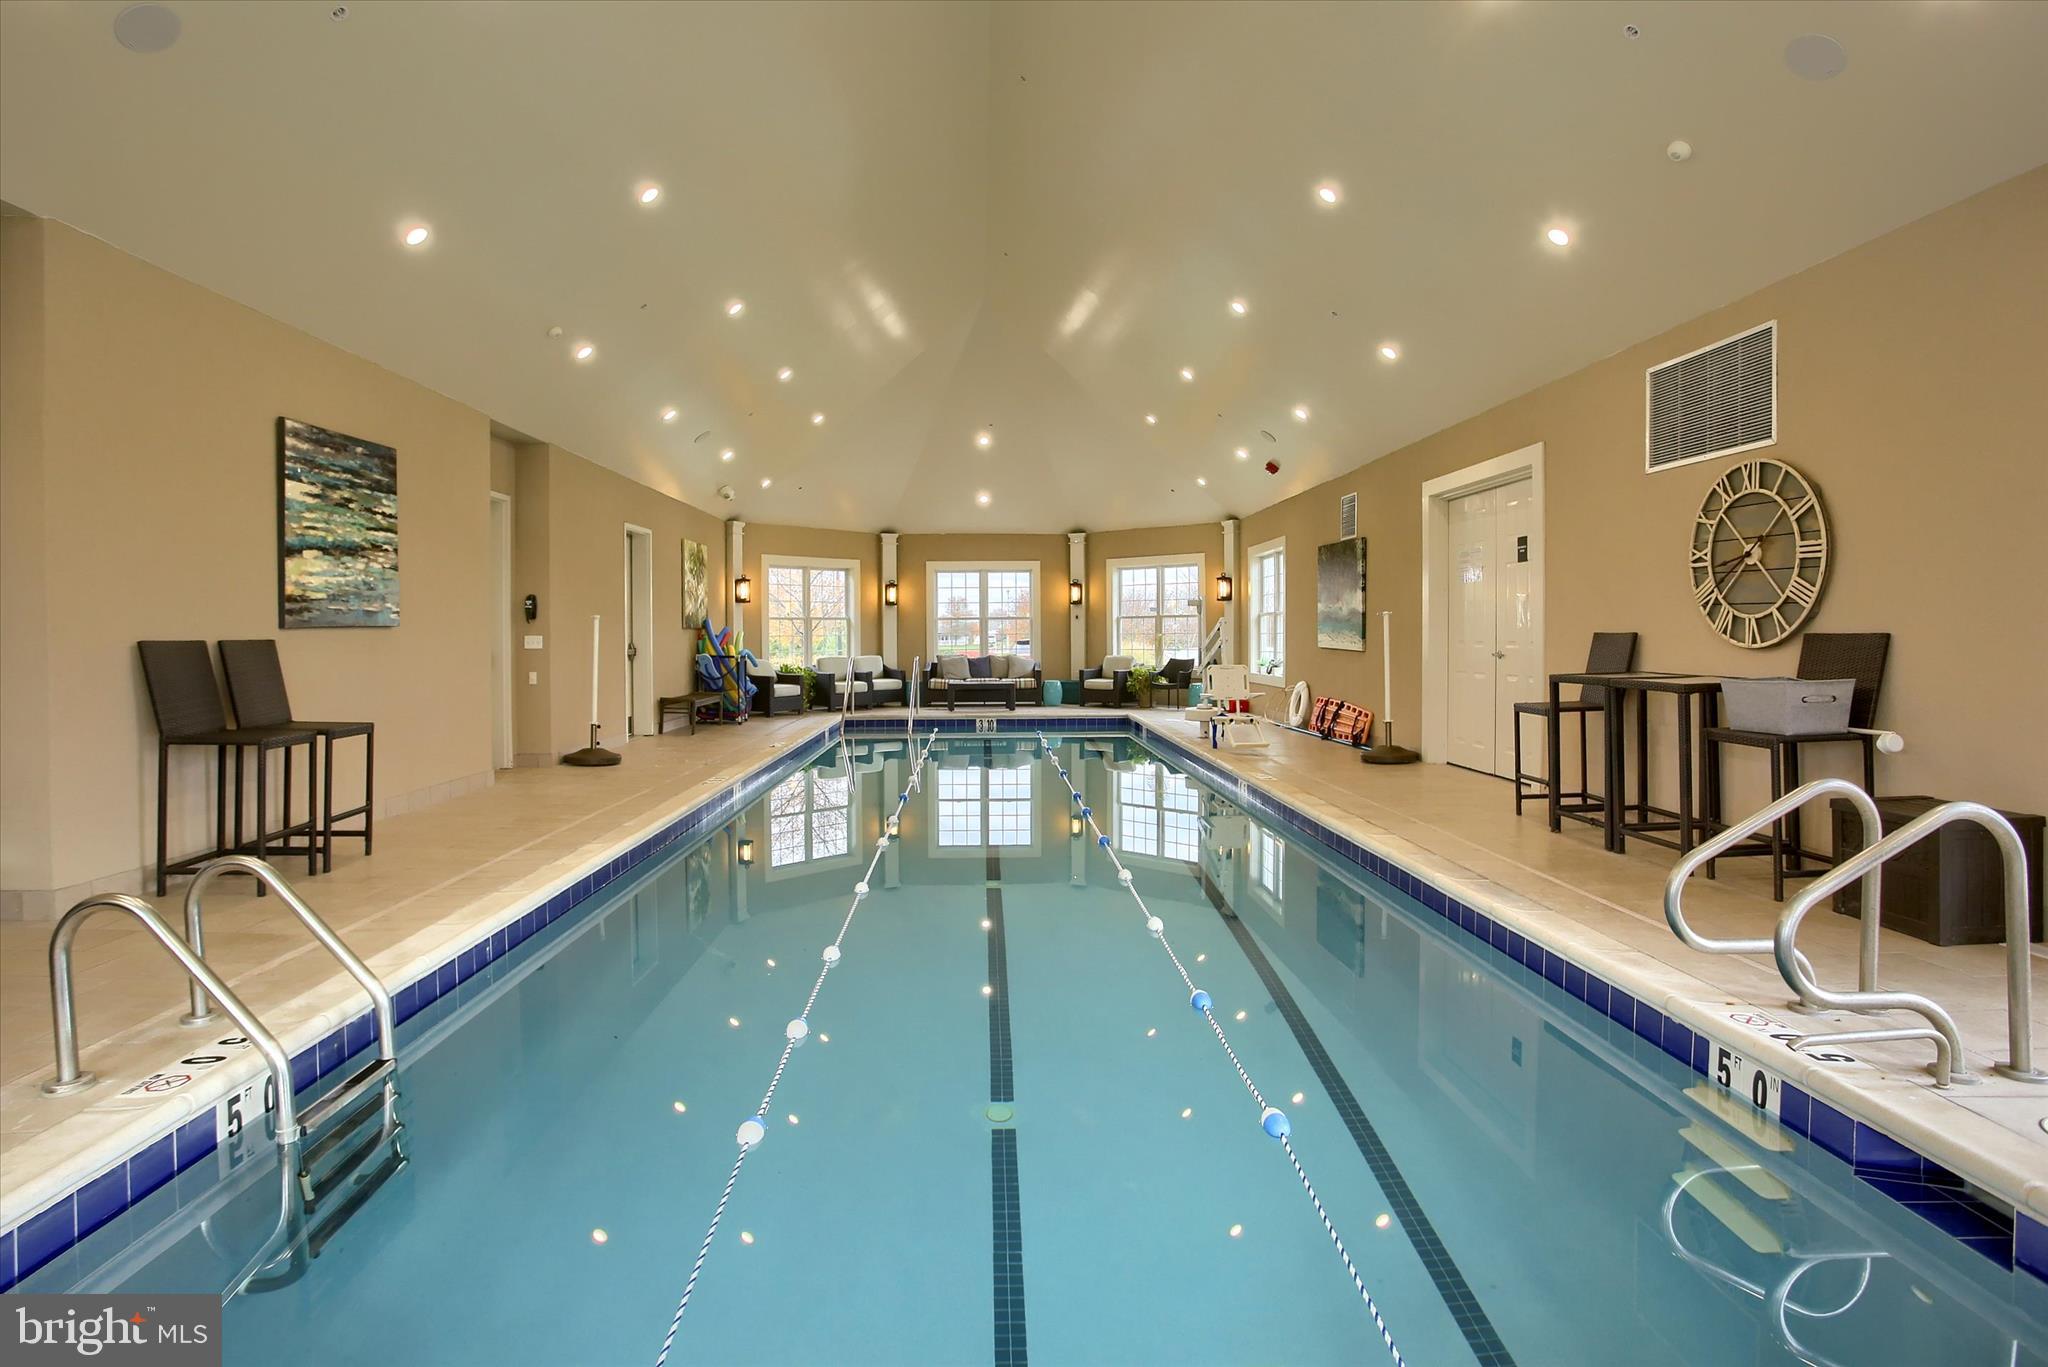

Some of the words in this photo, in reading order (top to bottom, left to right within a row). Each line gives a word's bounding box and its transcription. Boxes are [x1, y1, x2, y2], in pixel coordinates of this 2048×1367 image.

[978, 719, 984, 733] 3
[986, 719, 995, 733] 10
[1716, 1047, 1732, 1088] 5
[1734, 1055, 1742, 1071] FT
[1752, 1069, 1768, 1110] 0
[1770, 1076, 1779, 1093] IN
[227, 1093, 243, 1138] 5
